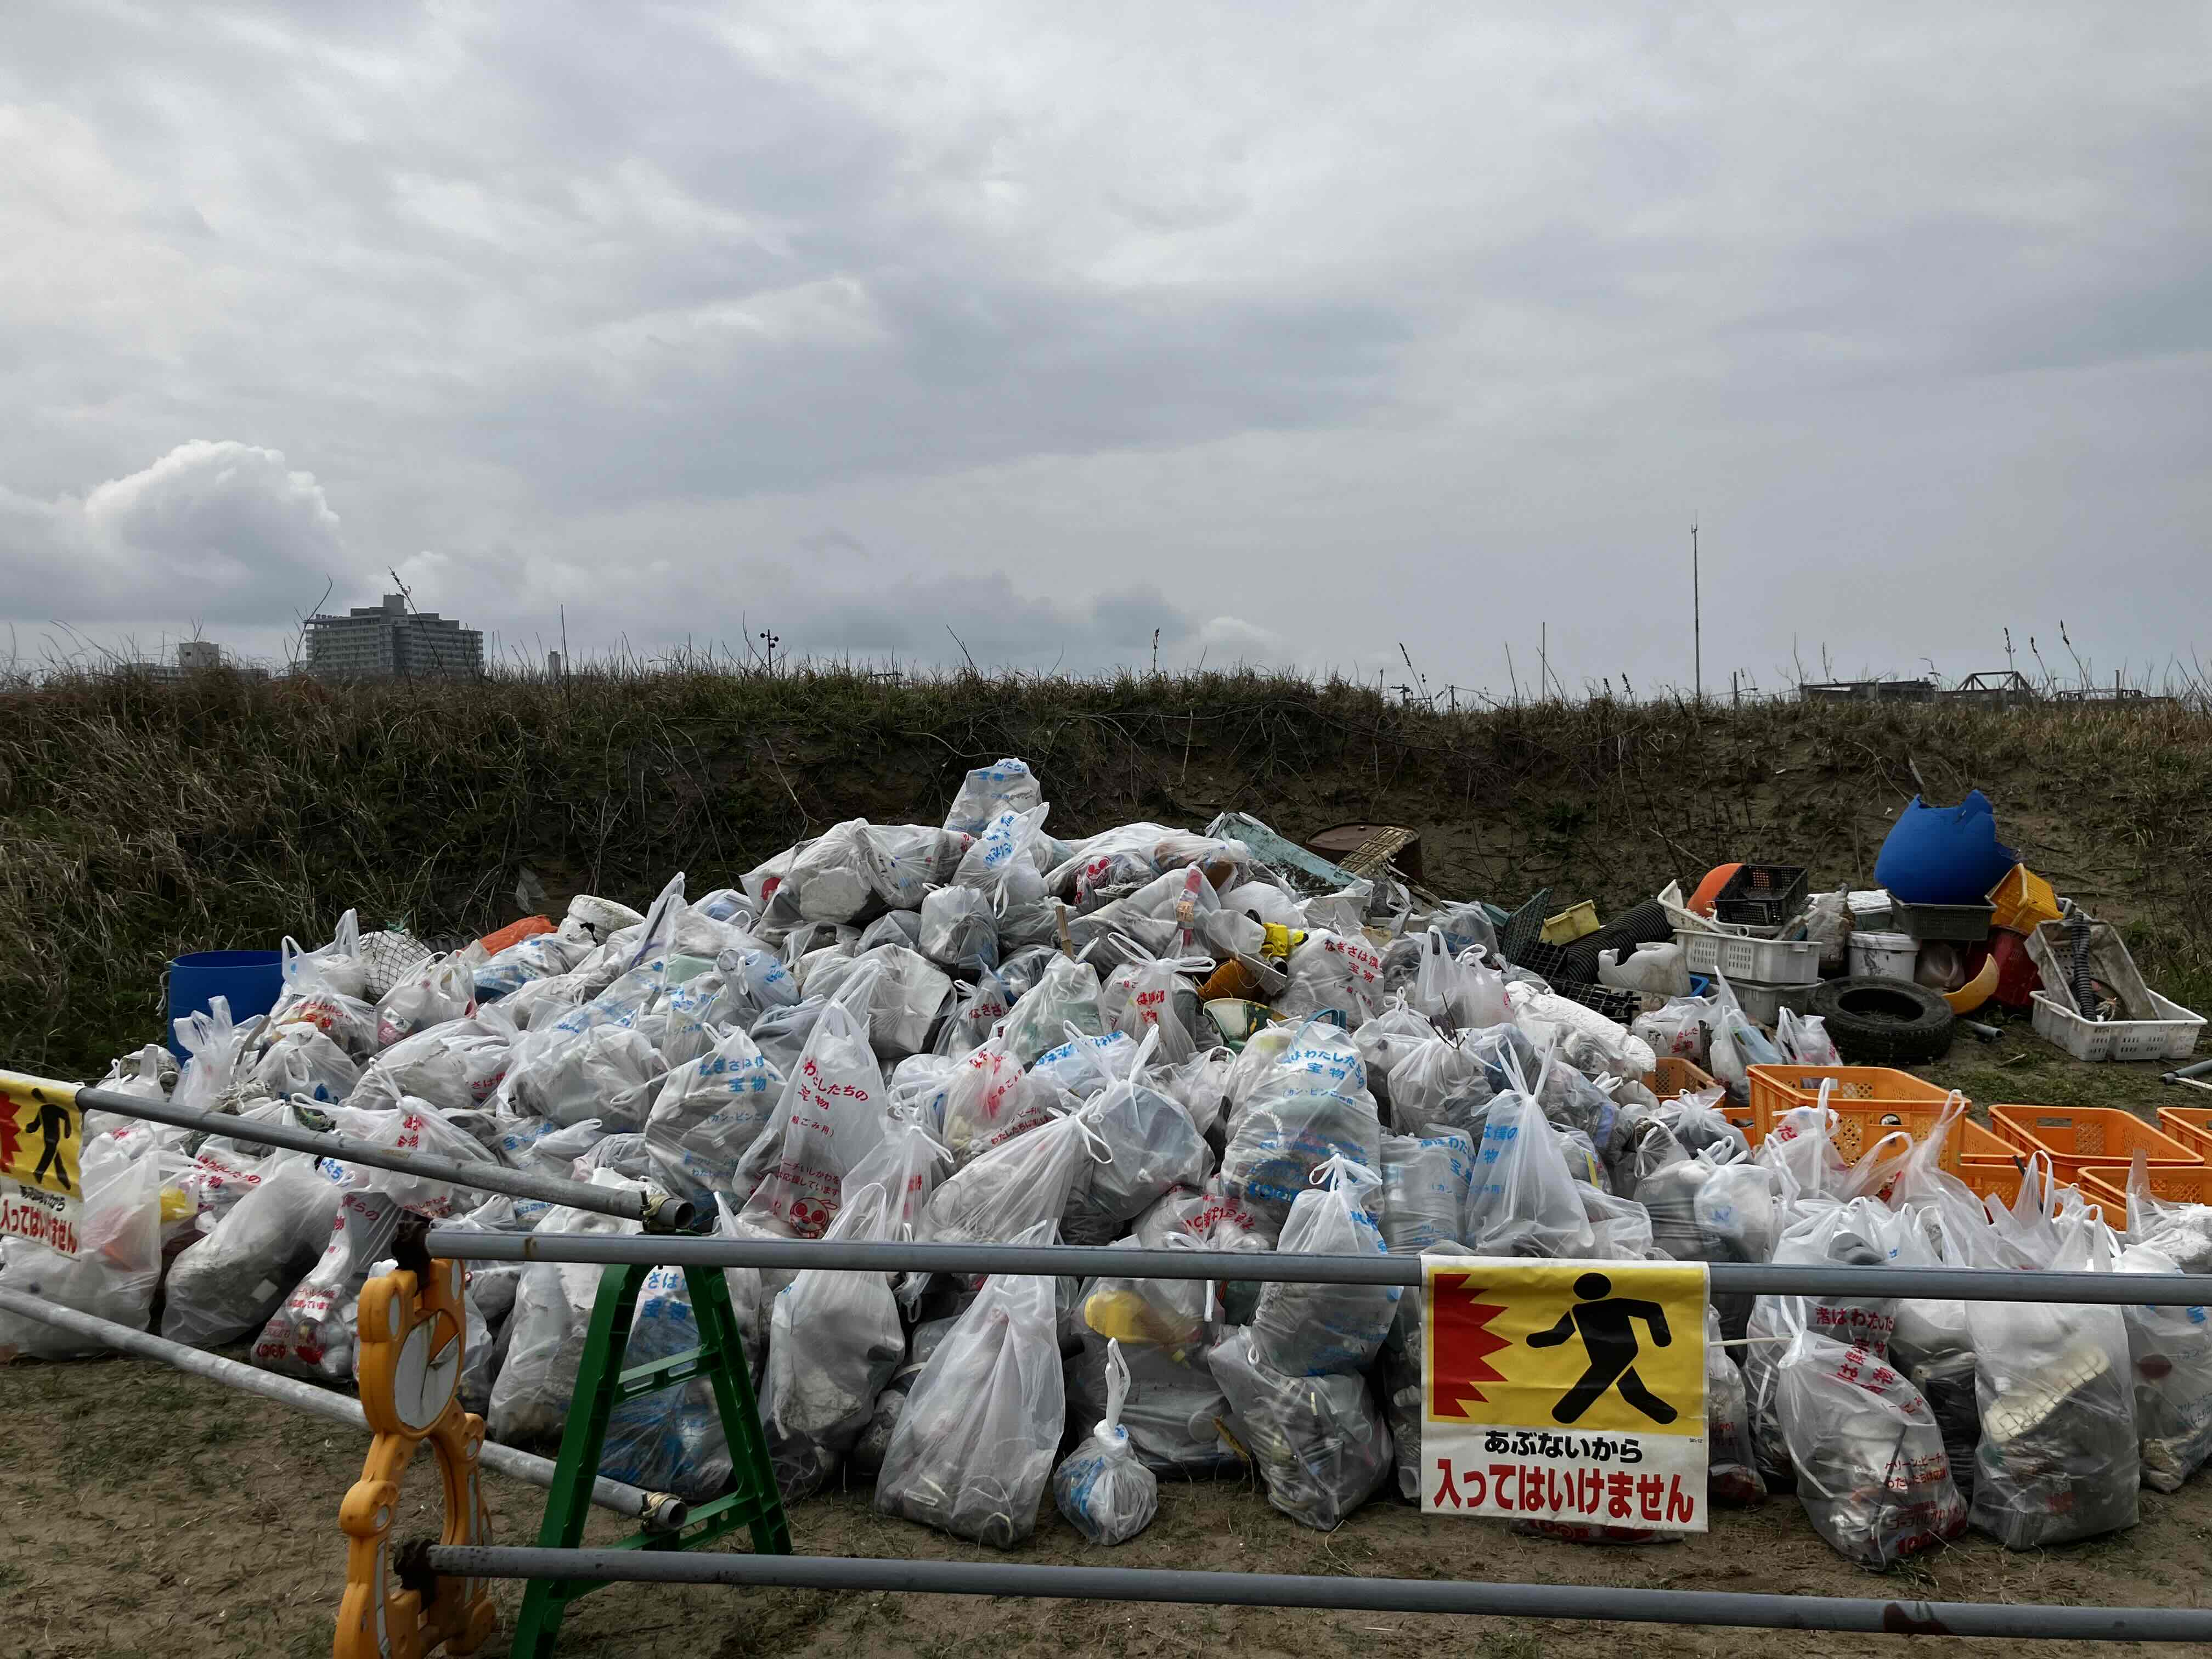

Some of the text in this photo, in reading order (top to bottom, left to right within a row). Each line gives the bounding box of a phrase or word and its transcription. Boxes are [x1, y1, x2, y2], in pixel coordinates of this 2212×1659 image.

[729, 1076, 768, 1092] 宝物
[1306, 1062, 1346, 1080] 宝物
[1483, 1430, 1643, 1464] あぶないから
[1433, 1458, 1695, 1523] 入ってはいけません
